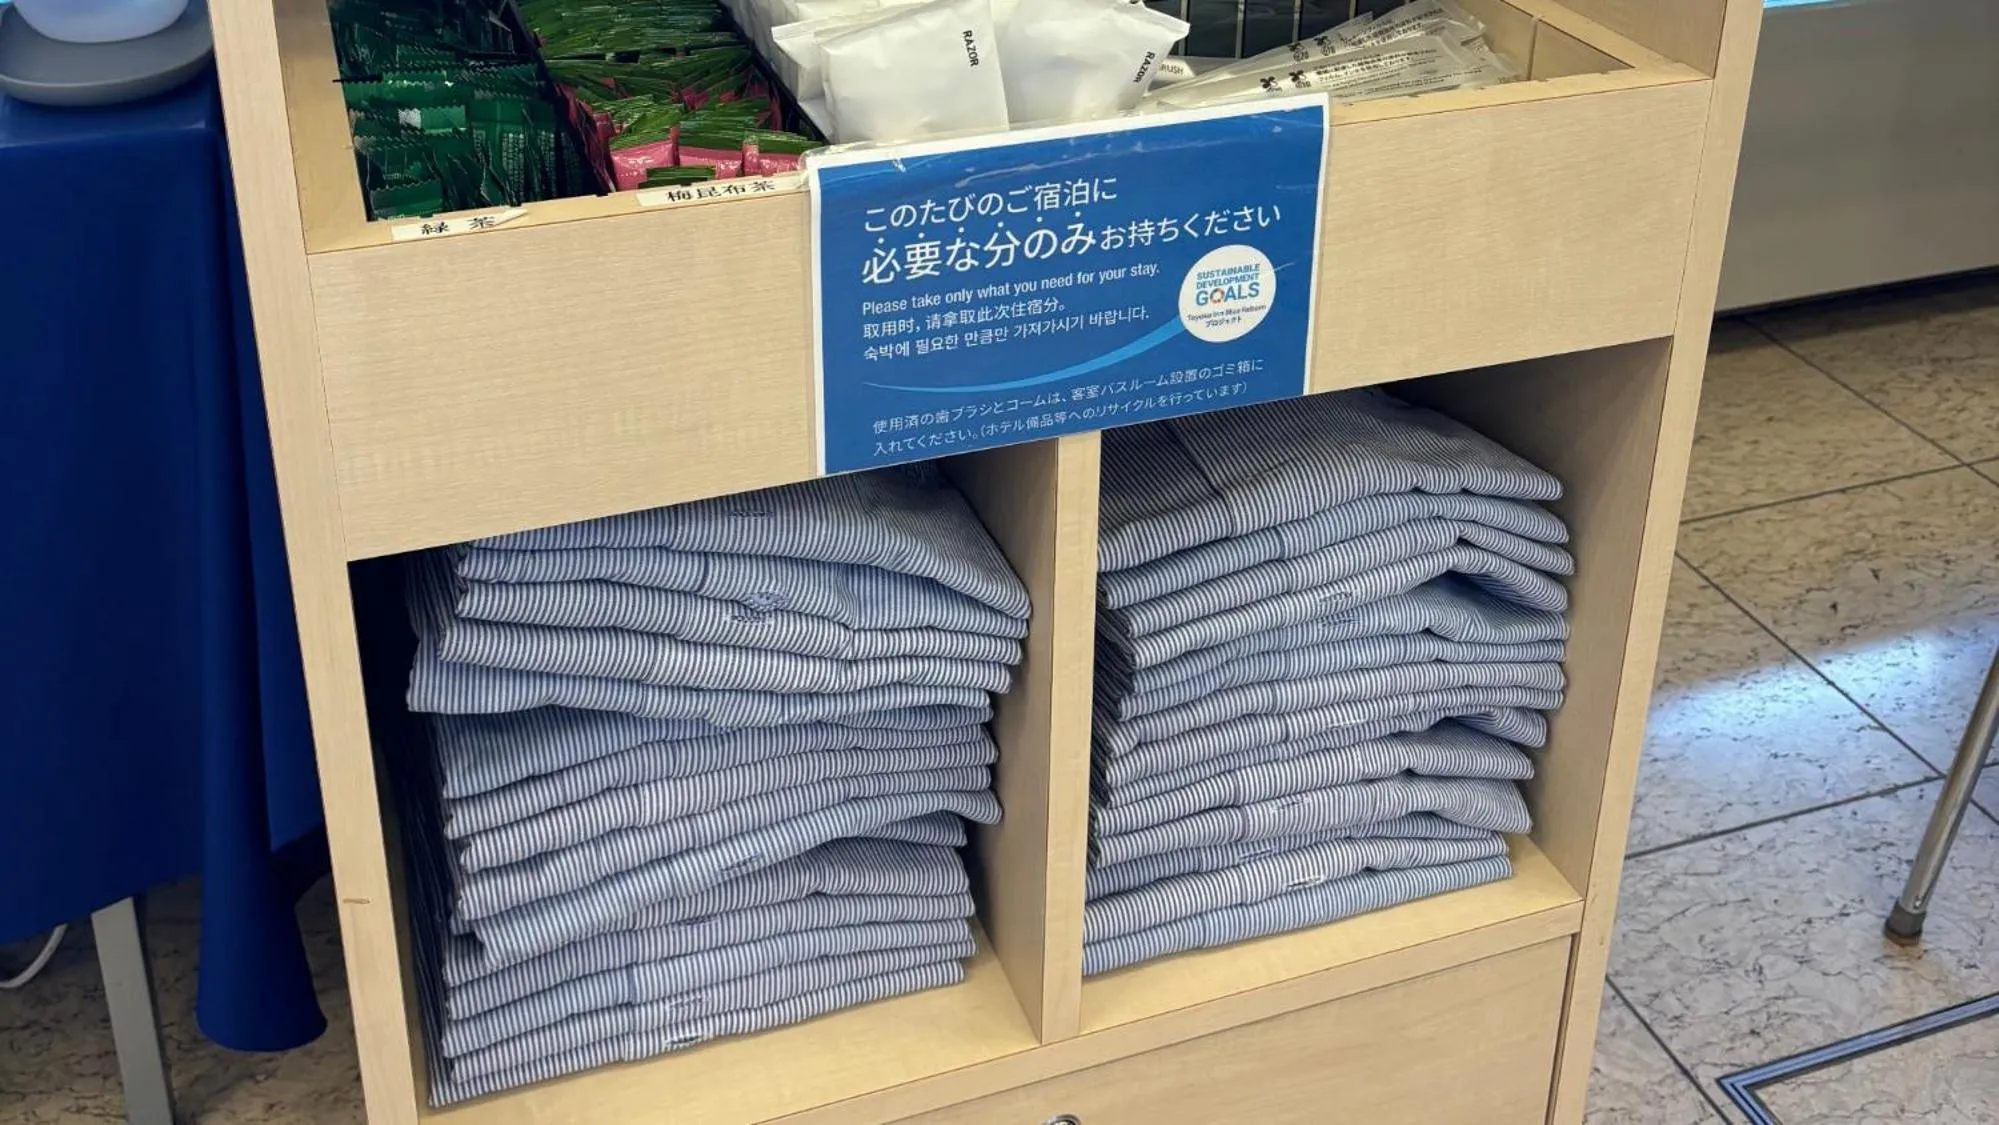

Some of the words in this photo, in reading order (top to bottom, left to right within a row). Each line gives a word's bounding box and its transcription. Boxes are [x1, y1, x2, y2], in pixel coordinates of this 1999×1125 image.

[962, 29, 979, 67] RAZOR
[1132, 51, 1156, 83] RAZOR
[1159, 63, 1184, 75] RUSH
[666, 180, 776, 202] 梅昆布茶
[865, 177, 1117, 232] このたびのご宿泊に
[862, 205, 1281, 284] 必要な分のみお持ちください
[1196, 263, 1261, 280] SUSTAINABLE
[1196, 272, 1260, 290] DEVELOPMENT
[862, 300, 907, 316] Please
[912, 295, 941, 309] take
[945, 289, 974, 304] only
[977, 282, 1010, 298] what
[1014, 282, 1037, 296] you
[1041, 273, 1073, 289] need
[1077, 271, 1095, 284] for
[1099, 267, 1127, 284] your
[1130, 263, 1160, 277] stay.
[1196, 281, 1260, 306] GOALS
[864, 340, 909, 361] 숙박에
[915, 334, 958, 355] 필요한
[964, 326, 1010, 347] 만큼만
[1014, 315, 1084, 338] 가져가시기
[1089, 305, 1150, 327] 바랍니다.
[1205, 315, 1242, 328] プロジェクト
[873, 359, 1265, 434] 使用済の歯ブラシとコームは、客室バスルーム設置のゴミ箱に
